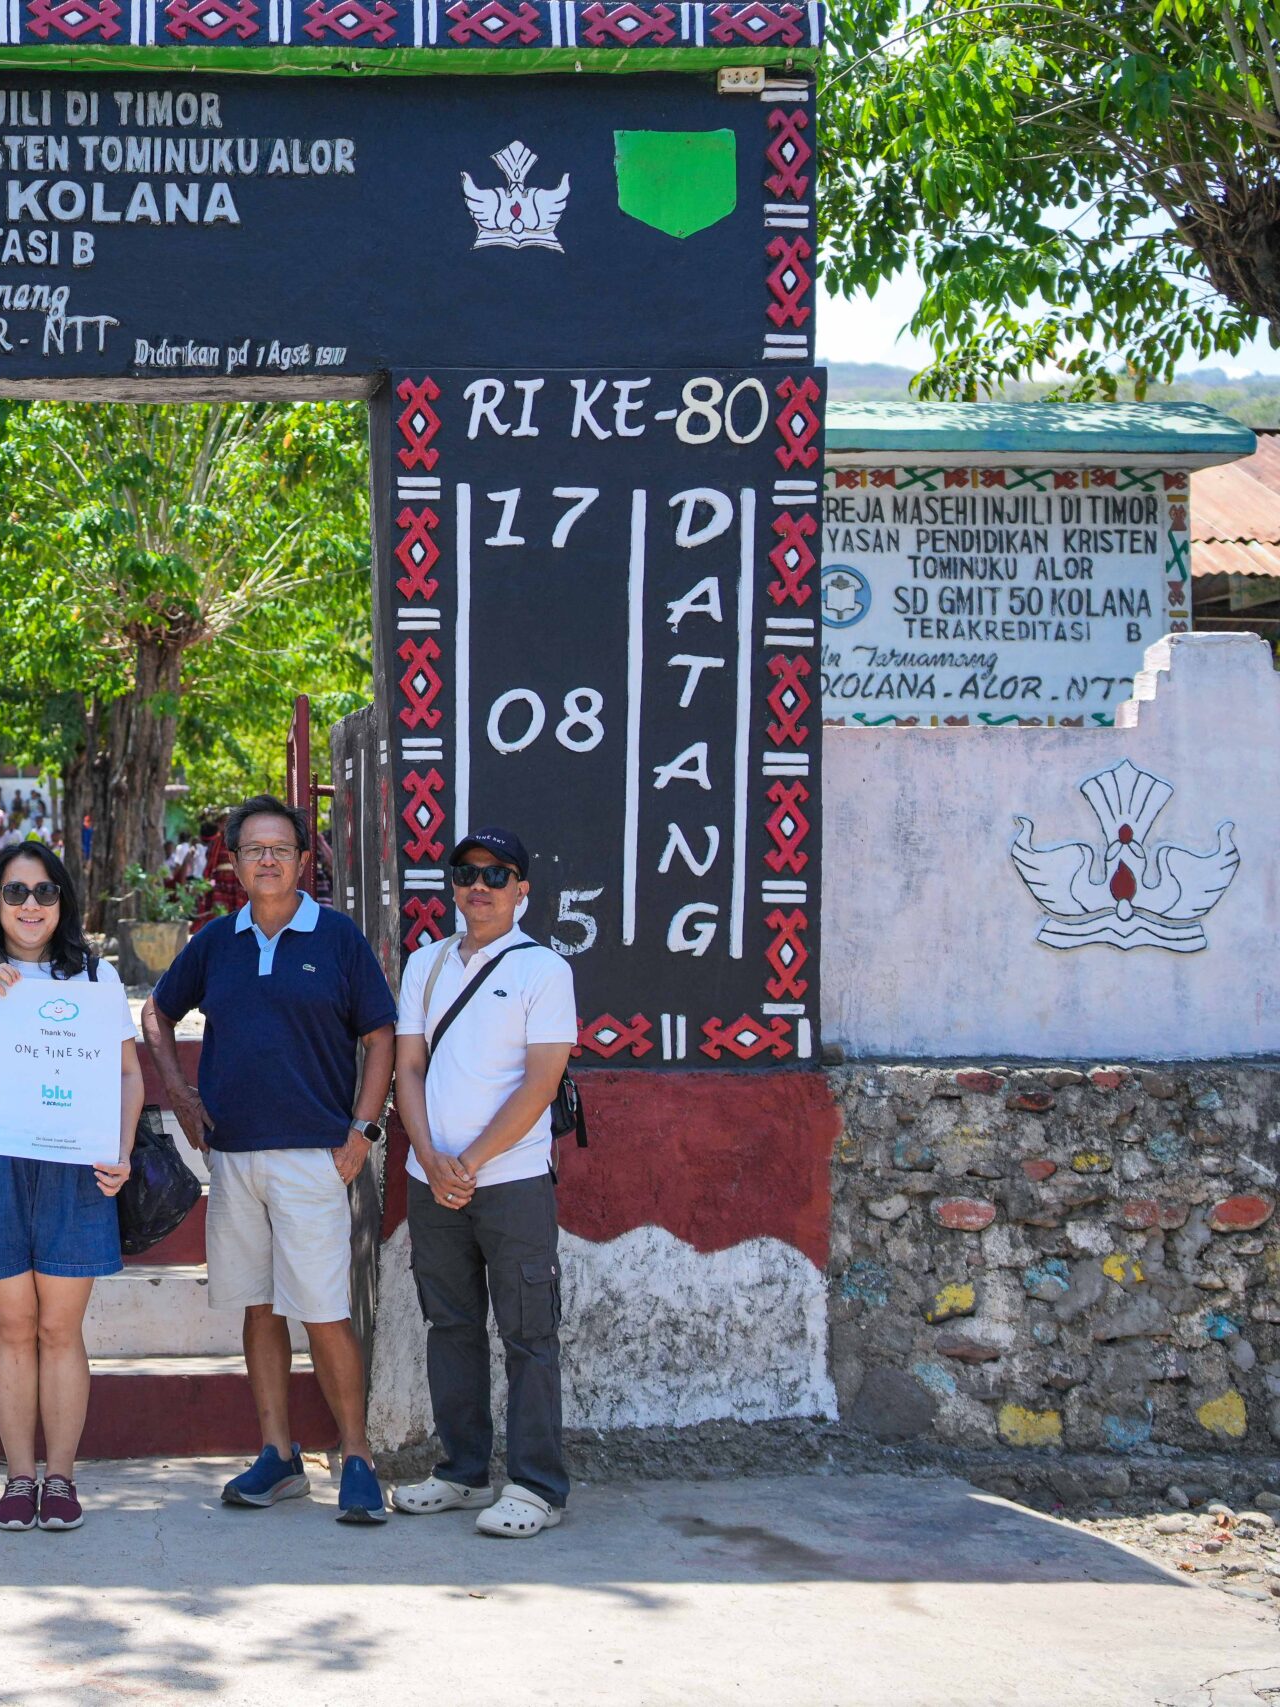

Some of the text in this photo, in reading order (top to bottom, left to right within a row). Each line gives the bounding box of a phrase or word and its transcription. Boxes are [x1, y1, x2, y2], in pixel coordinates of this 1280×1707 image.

[66, 91, 98, 126] DI
[115, 91, 223, 127] TIMOR
[78, 136, 258, 174] TOMINUKU
[267, 138, 356, 174] ALOR
[7, 179, 241, 224] KOLANA
[73, 231, 95, 267] B
[42, 314, 120, 356] NTT
[227, 338, 250, 374] pd
[464, 377, 545, 439] RI
[822, 495, 1158, 525] REJA MASEHI INJILI DI TIMOR
[822, 528, 1157, 554] YASAN PENDIDIKAN KRISTEN
[907, 555, 1093, 581] TOMINUKU ALOR
[893, 586, 1152, 618] SD GMIT 50 KOLANA
[904, 618, 1142, 642] TERAKREDITASI B
[959, 673, 1042, 700] ALOR
[487, 687, 604, 754] 08
[40, 1028, 76, 1038] Thank You
[14, 1043, 39, 1059] ONE
[77, 1047, 101, 1060] SKY
[41, 1084, 72, 1099] blu
